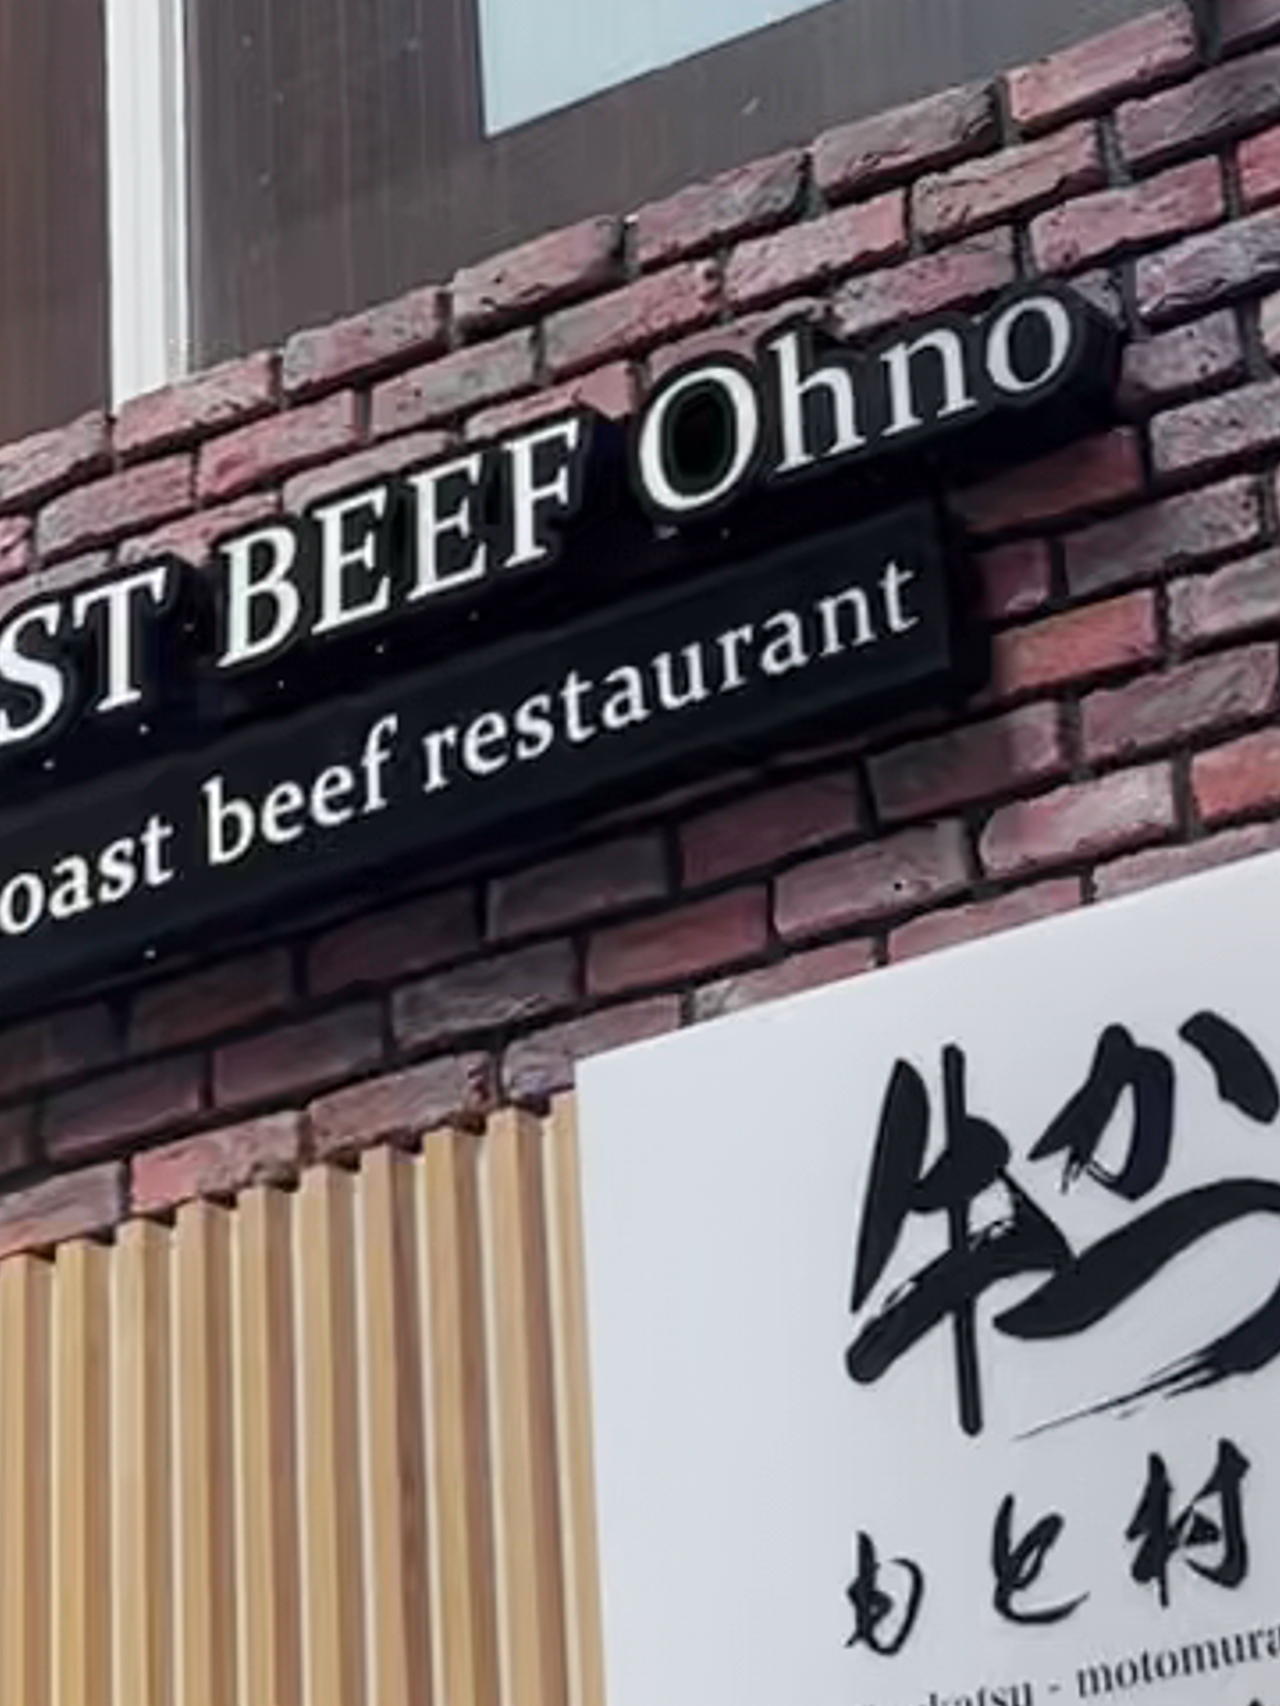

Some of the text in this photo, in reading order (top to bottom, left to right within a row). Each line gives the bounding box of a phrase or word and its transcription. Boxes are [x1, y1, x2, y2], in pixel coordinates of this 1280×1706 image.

[217, 422, 586, 669] BEEF
[634, 290, 1081, 514] Ohno
[207, 700, 397, 868] beef
[420, 556, 918, 796] restaurant
[844, 1438, 1252, 1658] もと村
